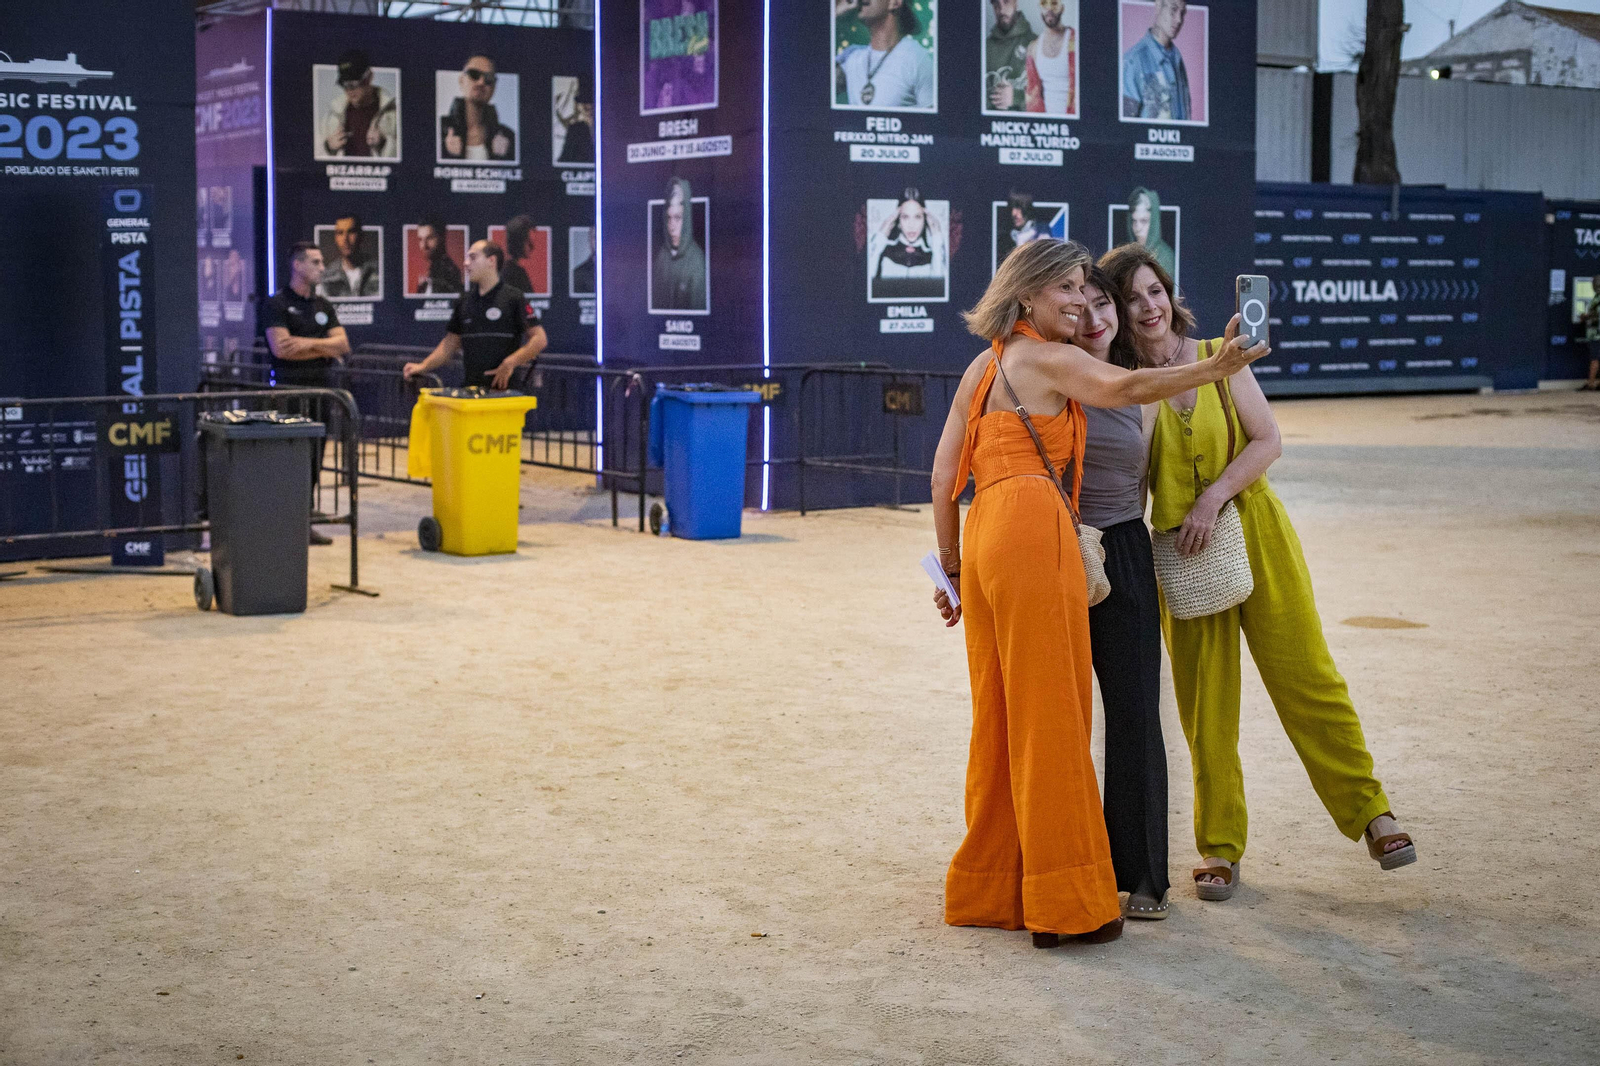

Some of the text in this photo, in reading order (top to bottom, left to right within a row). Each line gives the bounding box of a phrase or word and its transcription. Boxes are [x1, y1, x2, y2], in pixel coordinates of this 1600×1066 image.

[37, 93, 137, 111] FESTIVAL
[658, 118, 699, 138] BRESH
[866, 116, 902, 132] FEID
[991, 121, 1030, 135] NICKY
[1030, 123, 1059, 135] JAM
[0, 114, 140, 161] 2023
[877, 133, 910, 144] NITRO
[910, 134, 934, 145] JAM
[980, 133, 1080, 150] MANUEL TURIZO
[1148, 128, 1181, 143] DUKI
[860, 148, 910, 159] 20 JULIO
[1023, 152, 1054, 162] JULIO
[1152, 148, 1190, 158] AGOSTO
[4, 165, 139, 177] POBLADO DE SANCTI PETRI
[326, 164, 393, 177] BIZARRAP
[106, 218, 151, 228] GENERAL
[110, 231, 148, 245] PISTA
[1292, 279, 1399, 303] TAQUILLA
[887, 305, 928, 318] EMILIA
[118, 249, 148, 502] GERAL PISTA
[107, 421, 172, 447] CMF
[467, 433, 519, 454] CMF
[124, 541, 151, 554] CMF
